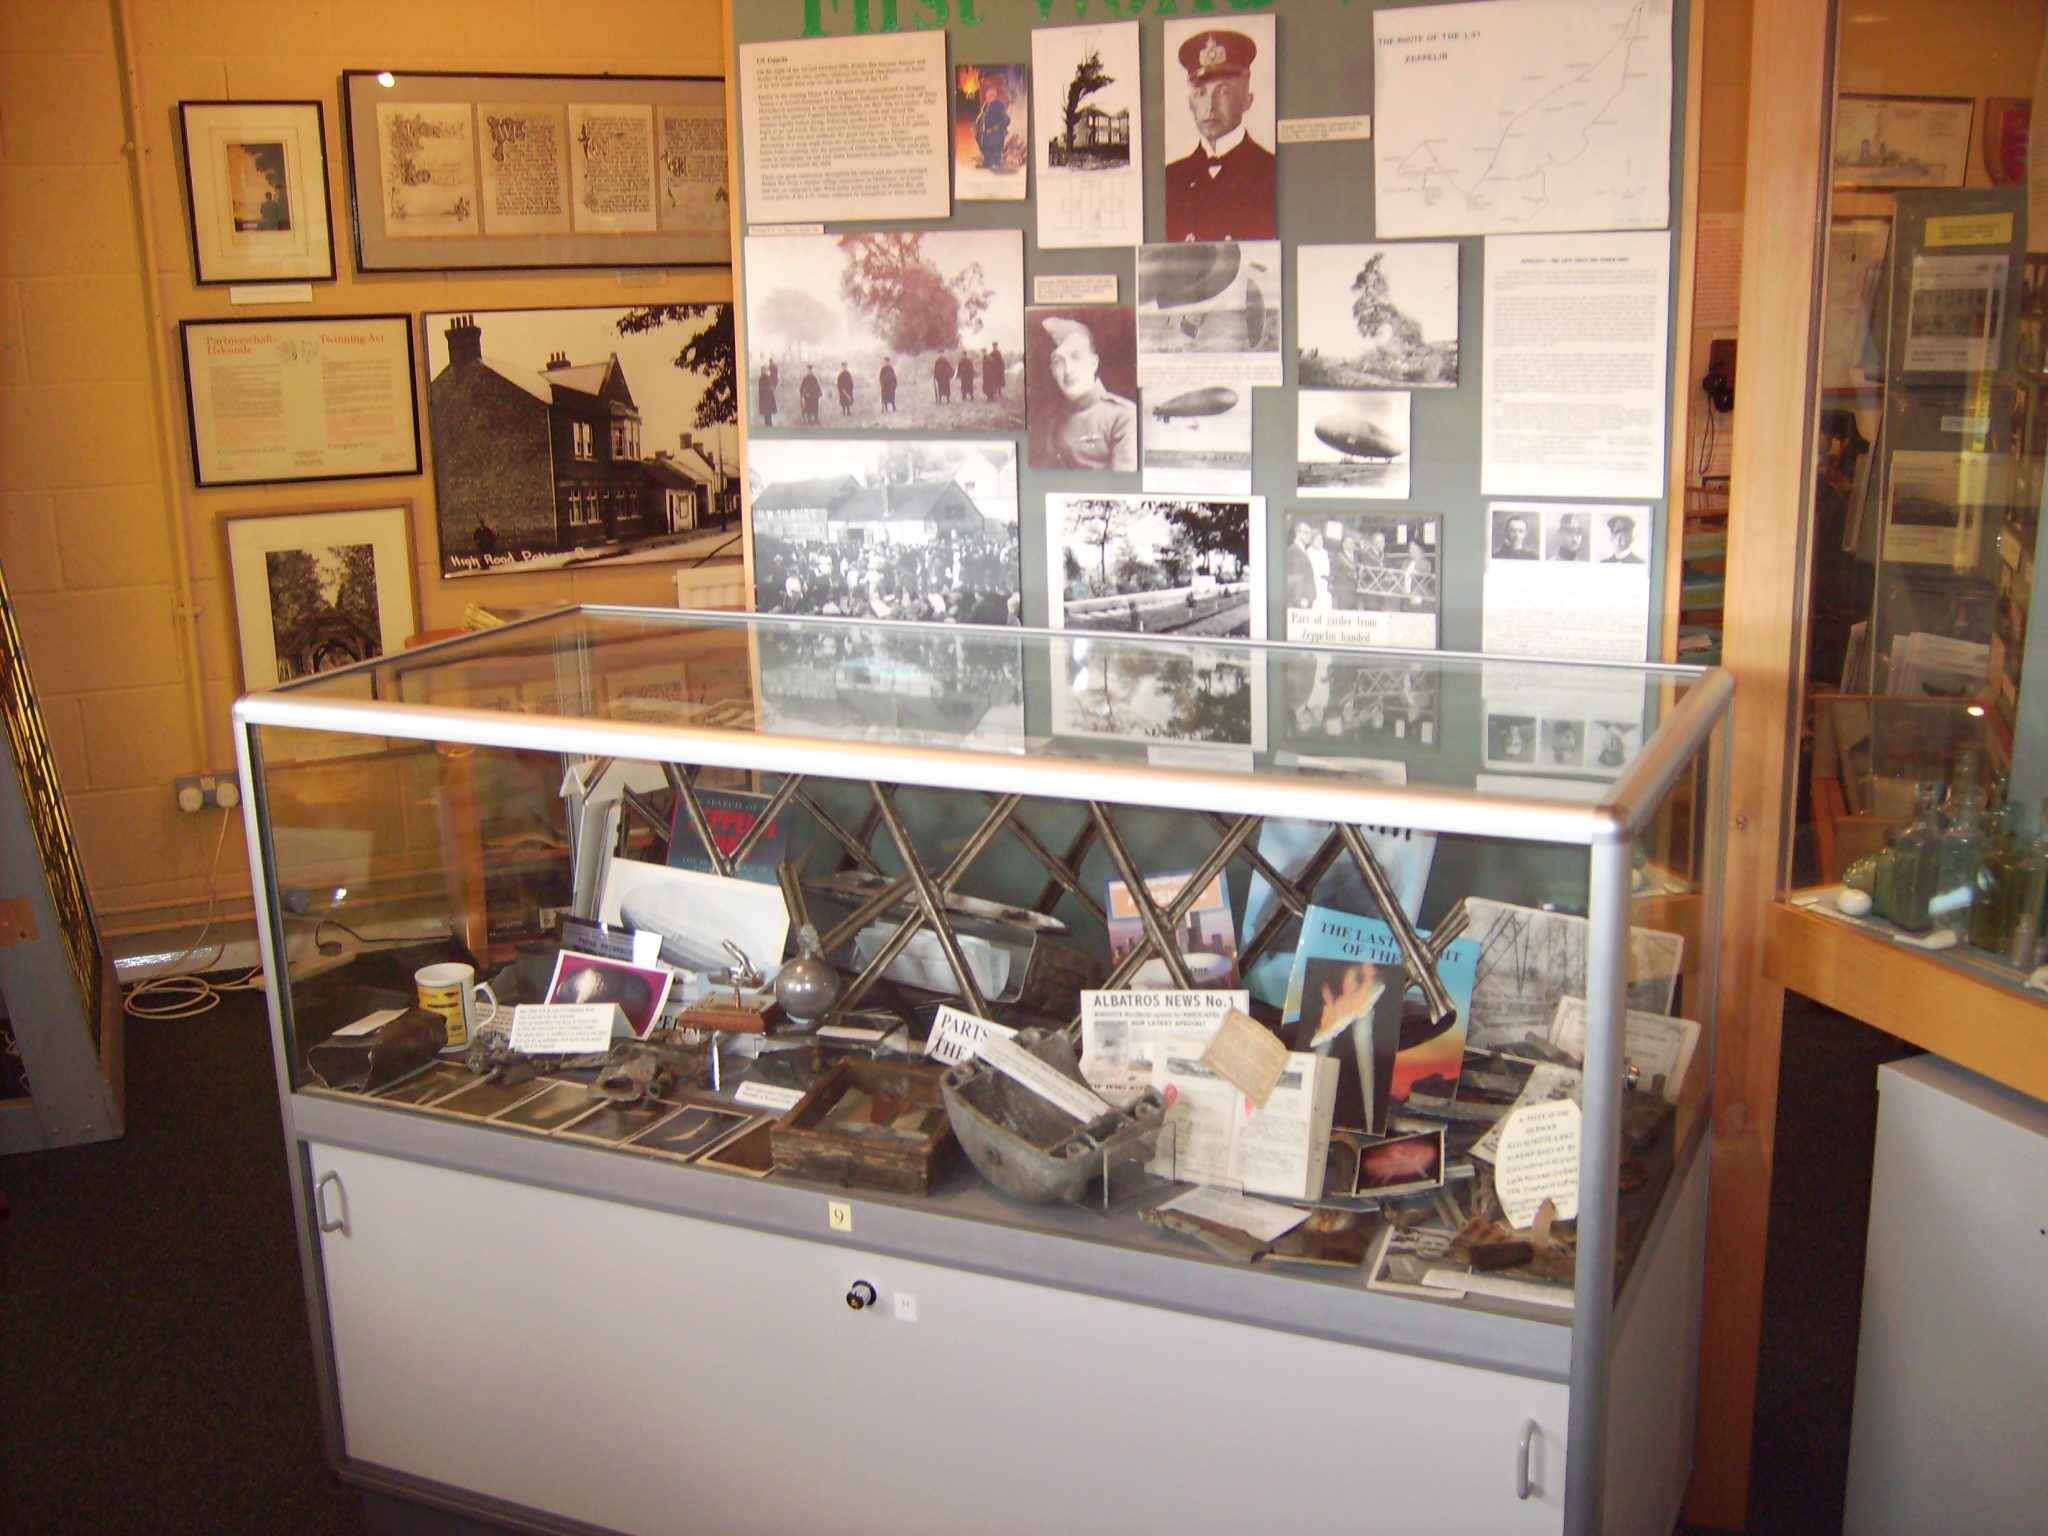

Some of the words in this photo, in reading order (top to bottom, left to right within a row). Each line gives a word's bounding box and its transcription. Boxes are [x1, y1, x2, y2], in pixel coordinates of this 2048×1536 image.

[1321, 921, 1352, 939] THE
[1356, 928, 1395, 949] LAST
[1342, 942, 1363, 957] OF
[1370, 948, 1400, 965] THE
[1094, 994, 1159, 1008] ALBATROS
[1165, 994, 1201, 1008] NEWS
[1206, 994, 1235, 1008] No.1
[940, 1013, 989, 1043] PARTS
[834, 1208, 844, 1224] 9
